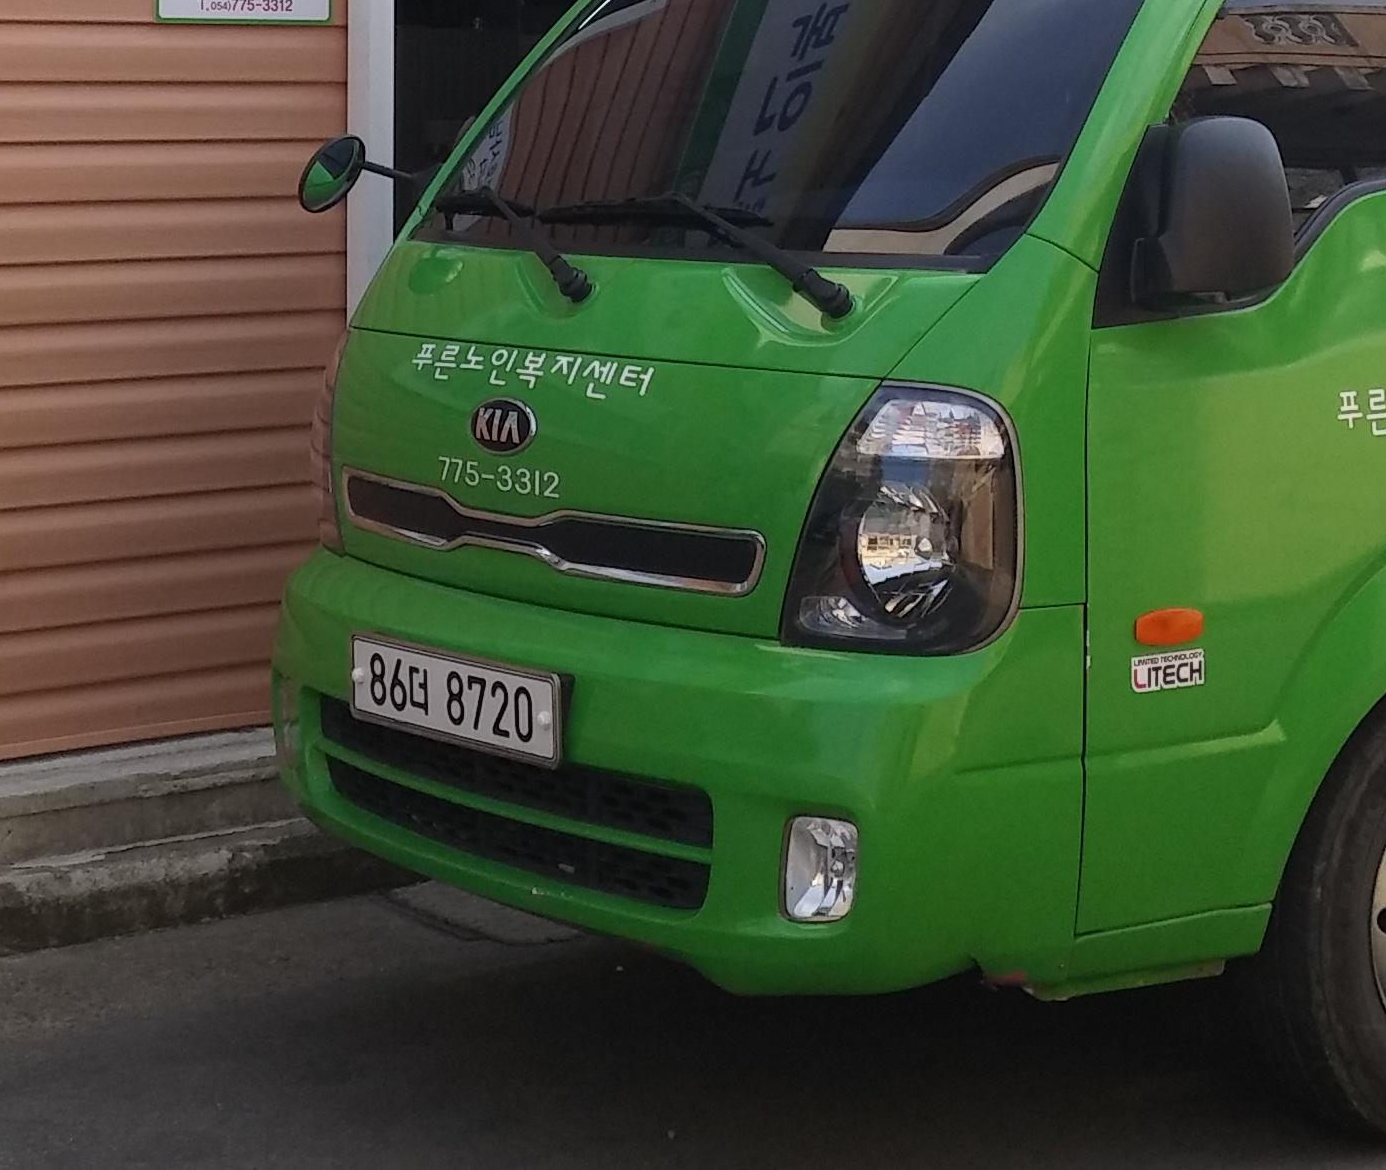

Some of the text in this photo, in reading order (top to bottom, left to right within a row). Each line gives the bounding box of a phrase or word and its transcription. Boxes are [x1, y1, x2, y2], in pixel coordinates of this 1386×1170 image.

[412, 343, 655, 399] 푸른노인복지센터
[475, 407, 520, 444] KIA
[438, 456, 560, 498] 775-3312
[1134, 661, 1202, 688] LITECH
[370, 653, 533, 742] 86더 8720
